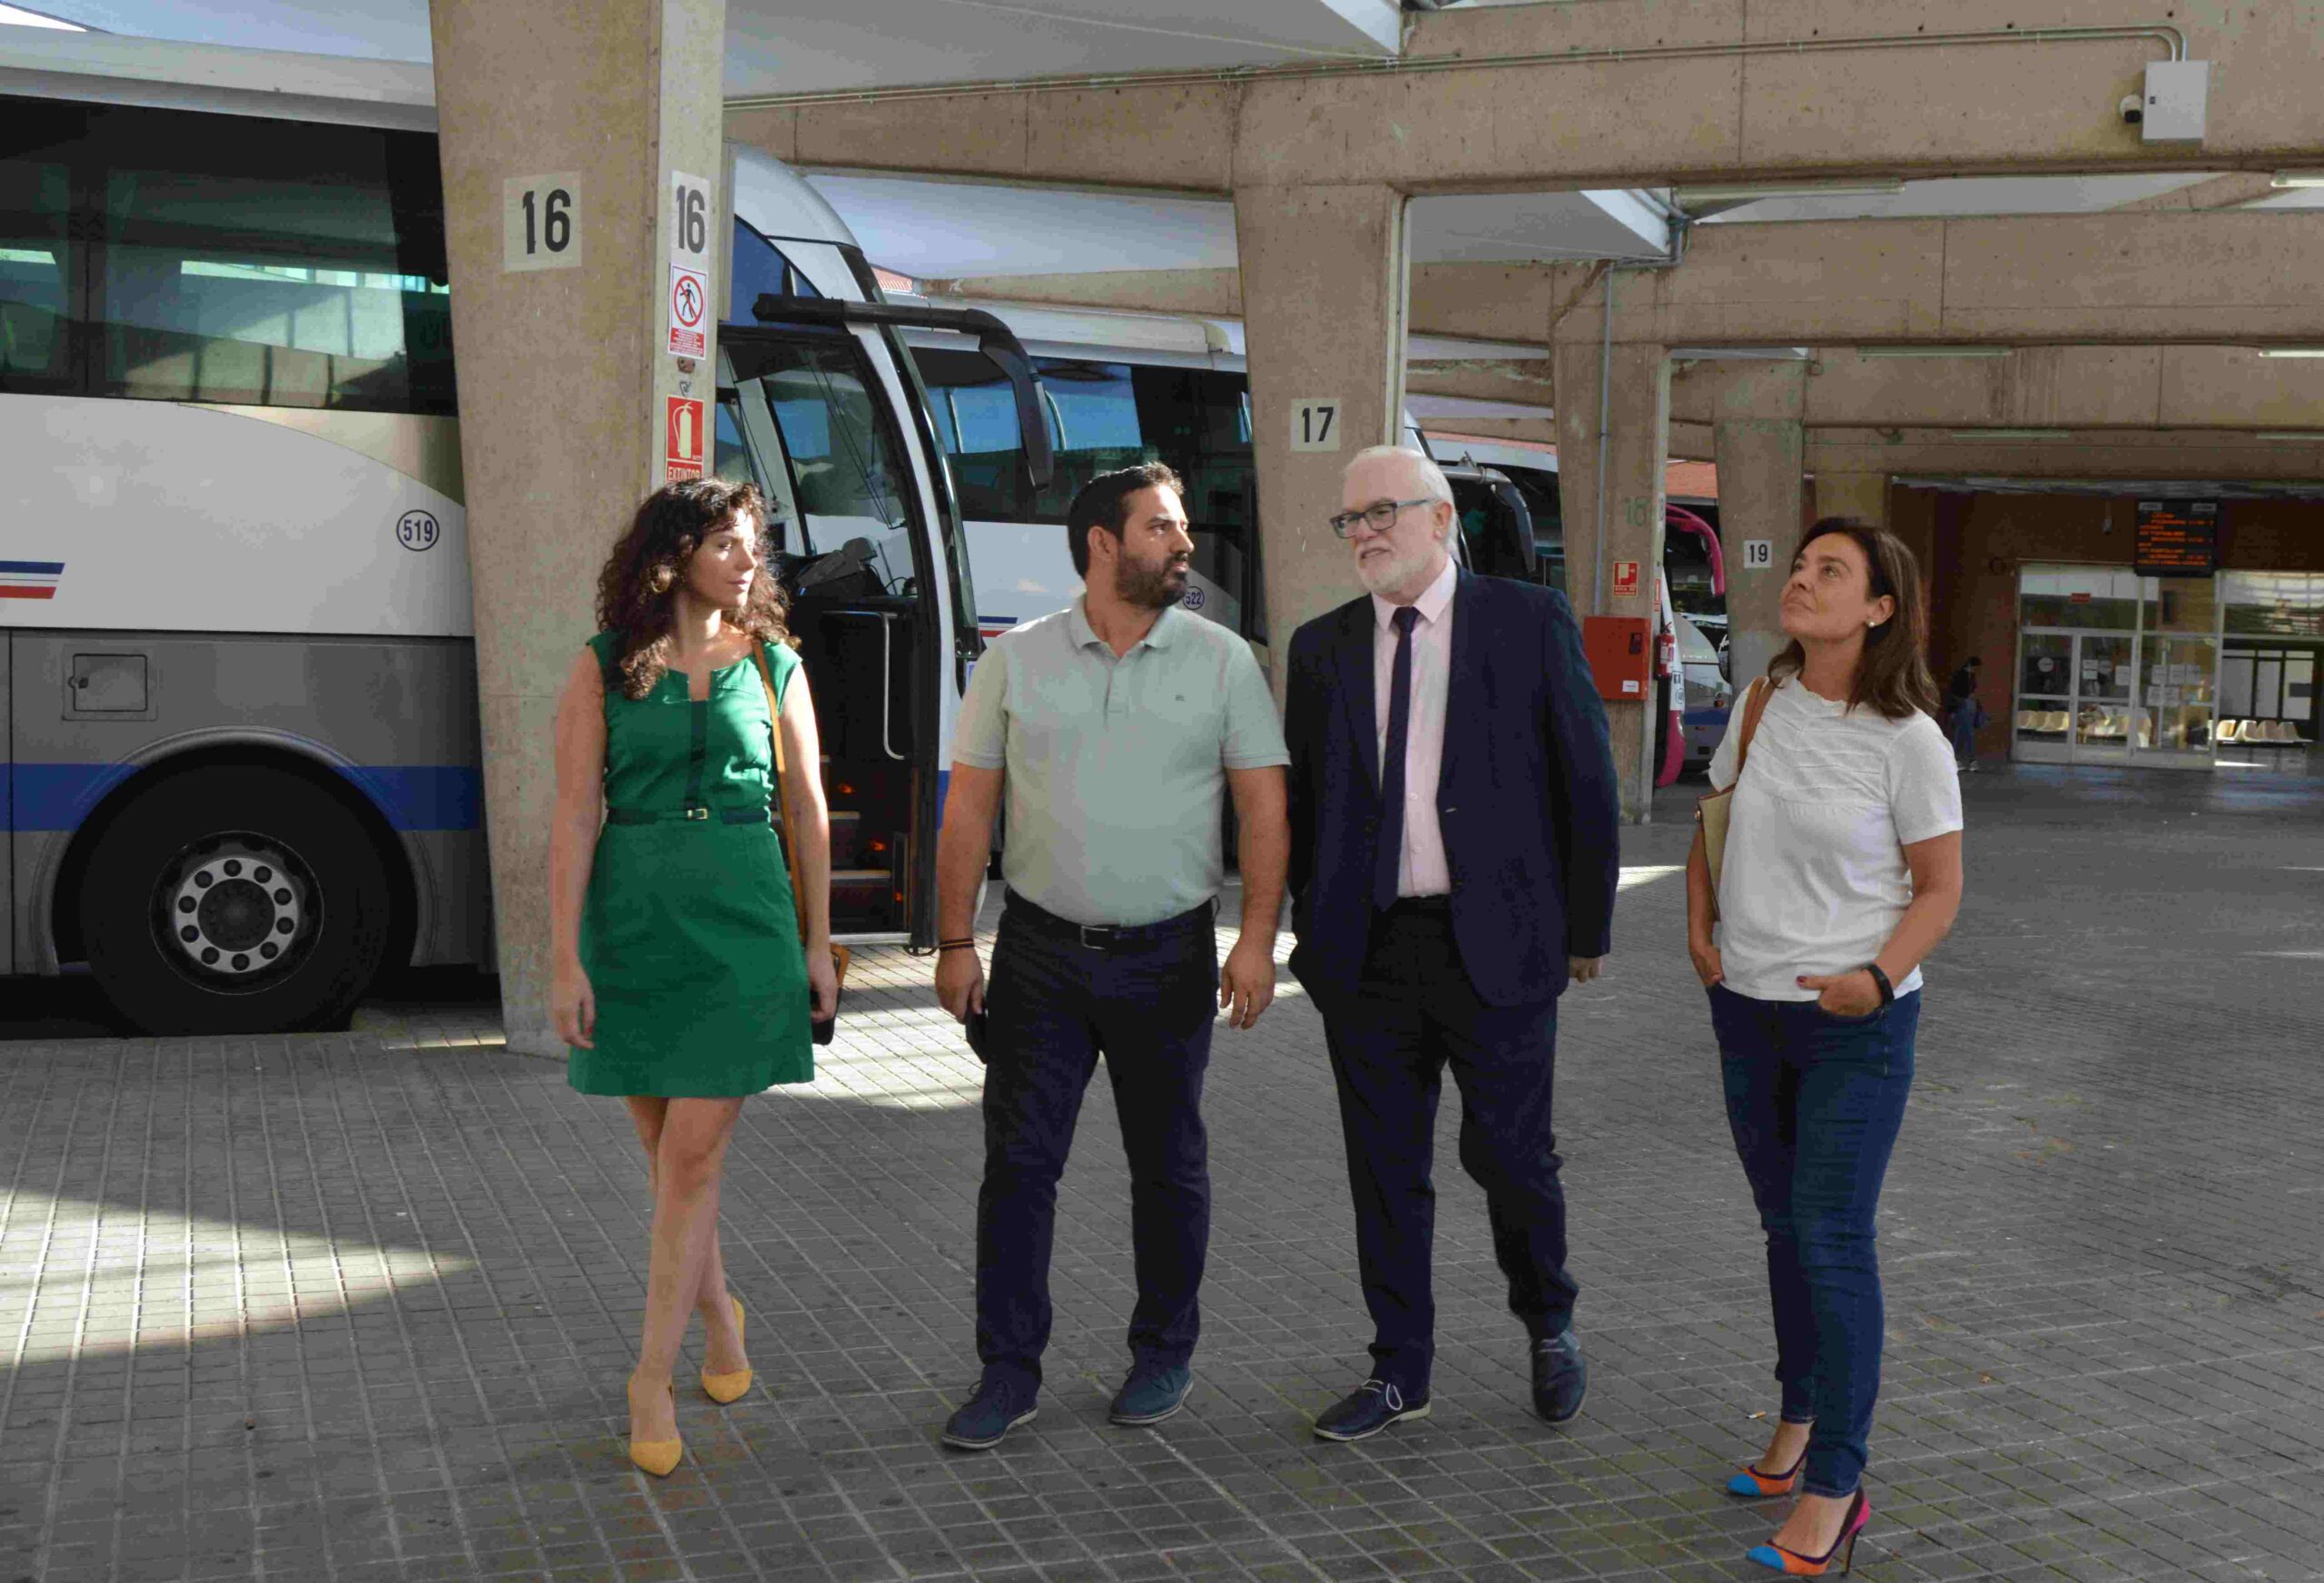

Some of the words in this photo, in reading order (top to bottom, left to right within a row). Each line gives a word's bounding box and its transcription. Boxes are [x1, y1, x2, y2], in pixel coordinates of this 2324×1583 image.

[523, 189, 571, 254] 16
[676, 185, 705, 253] 16
[1302, 407, 1334, 443] 17
[668, 467, 700, 481] EXTINTOR
[404, 519, 433, 542] 519
[1750, 544, 1768, 563] 19
